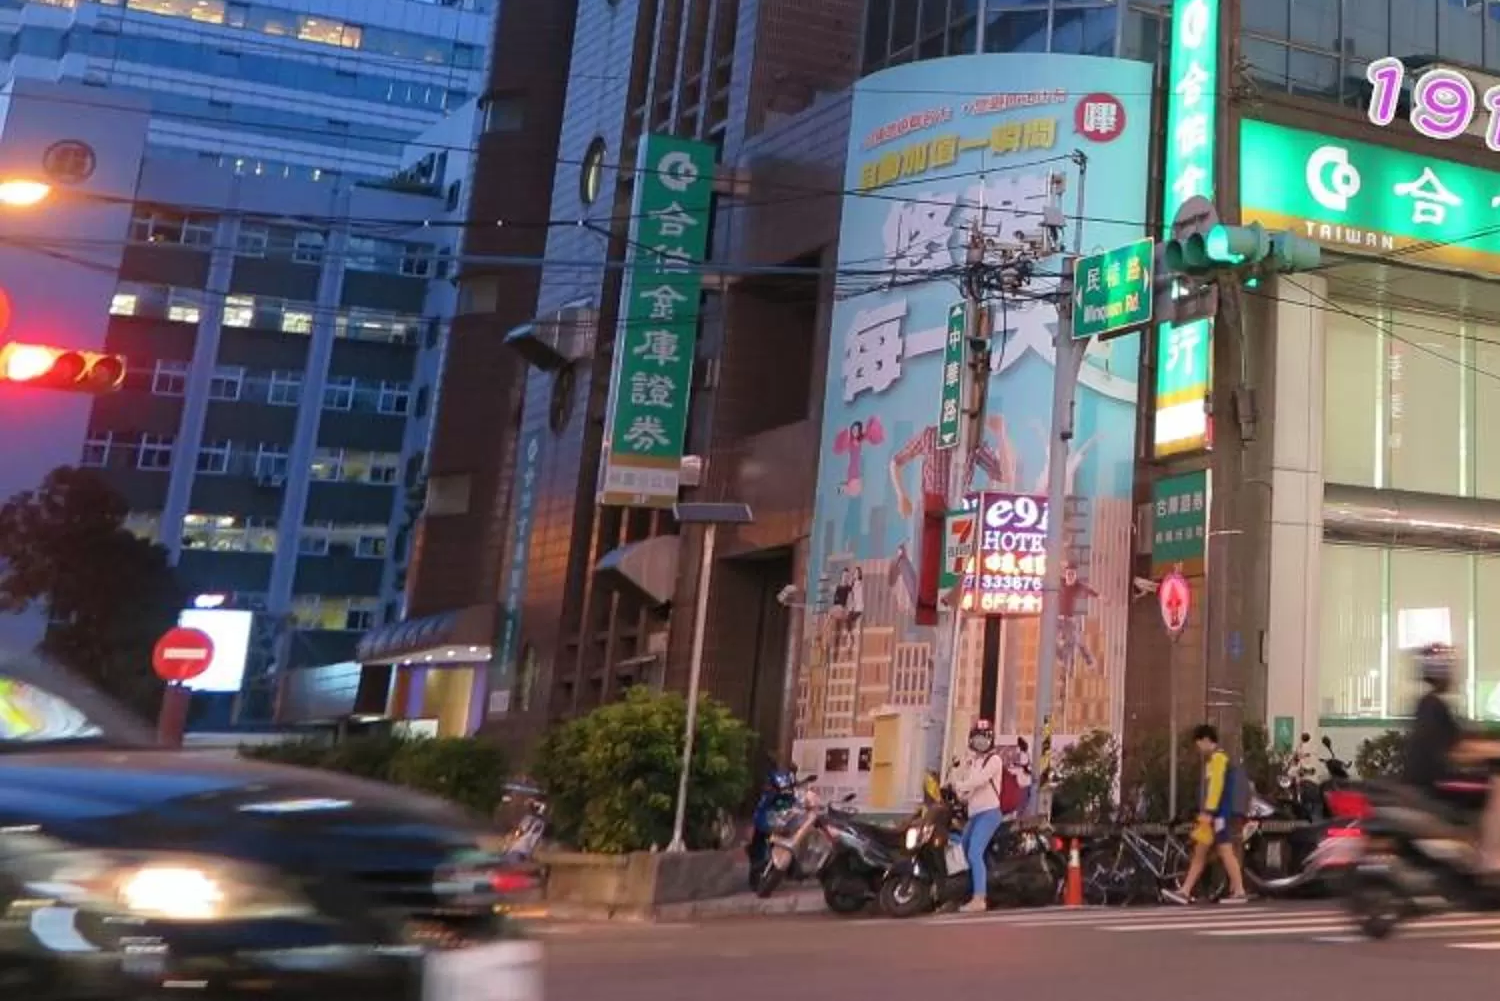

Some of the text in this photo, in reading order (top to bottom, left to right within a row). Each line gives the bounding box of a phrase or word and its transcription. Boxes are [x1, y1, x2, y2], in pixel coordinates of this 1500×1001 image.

[1305, 220, 1395, 250] TAIWAN
[623, 199, 699, 451] 合作金庫證券
[942, 331, 962, 423] 中華路
[981, 530, 1047, 552] HOTE
